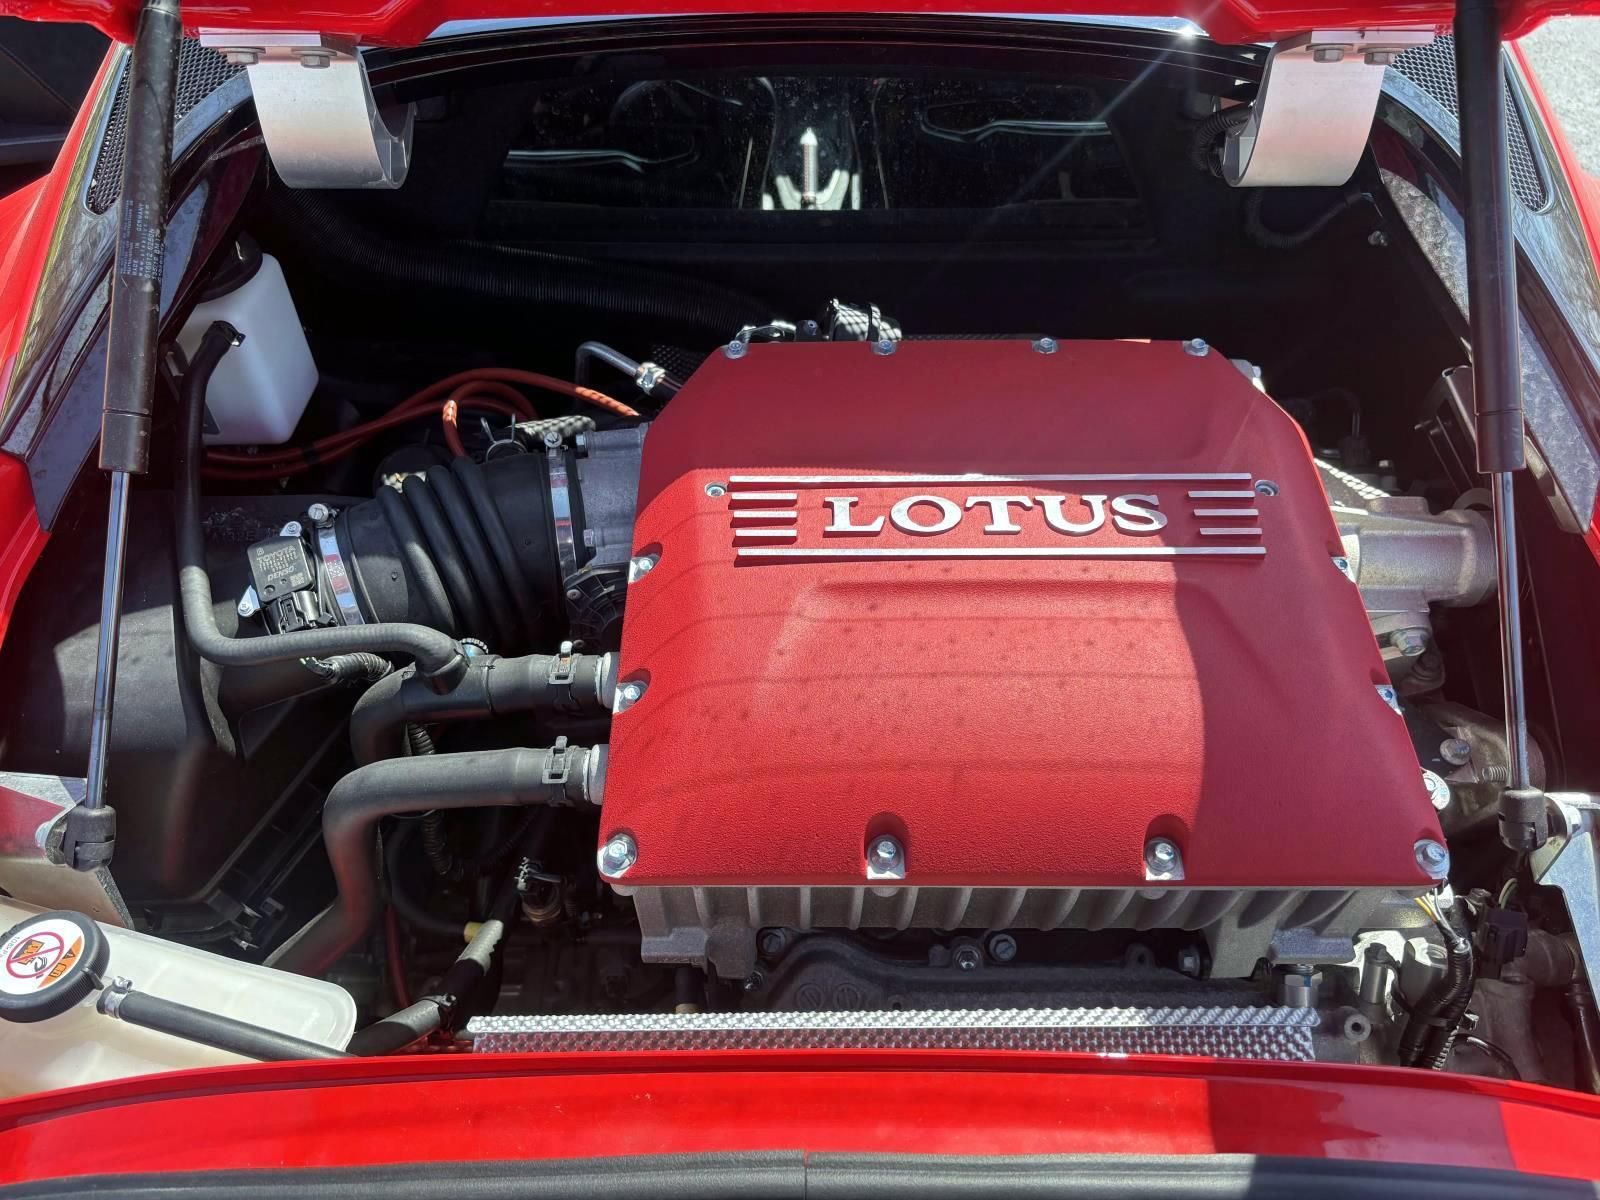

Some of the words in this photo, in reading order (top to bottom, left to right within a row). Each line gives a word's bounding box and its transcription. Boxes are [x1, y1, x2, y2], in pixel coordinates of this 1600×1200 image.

[136, 203, 144, 231] GERMANY
[823, 494, 1168, 537] LOTUS
[257, 545, 296, 562] TOYOTA
[267, 565, 295, 582] DENSO
